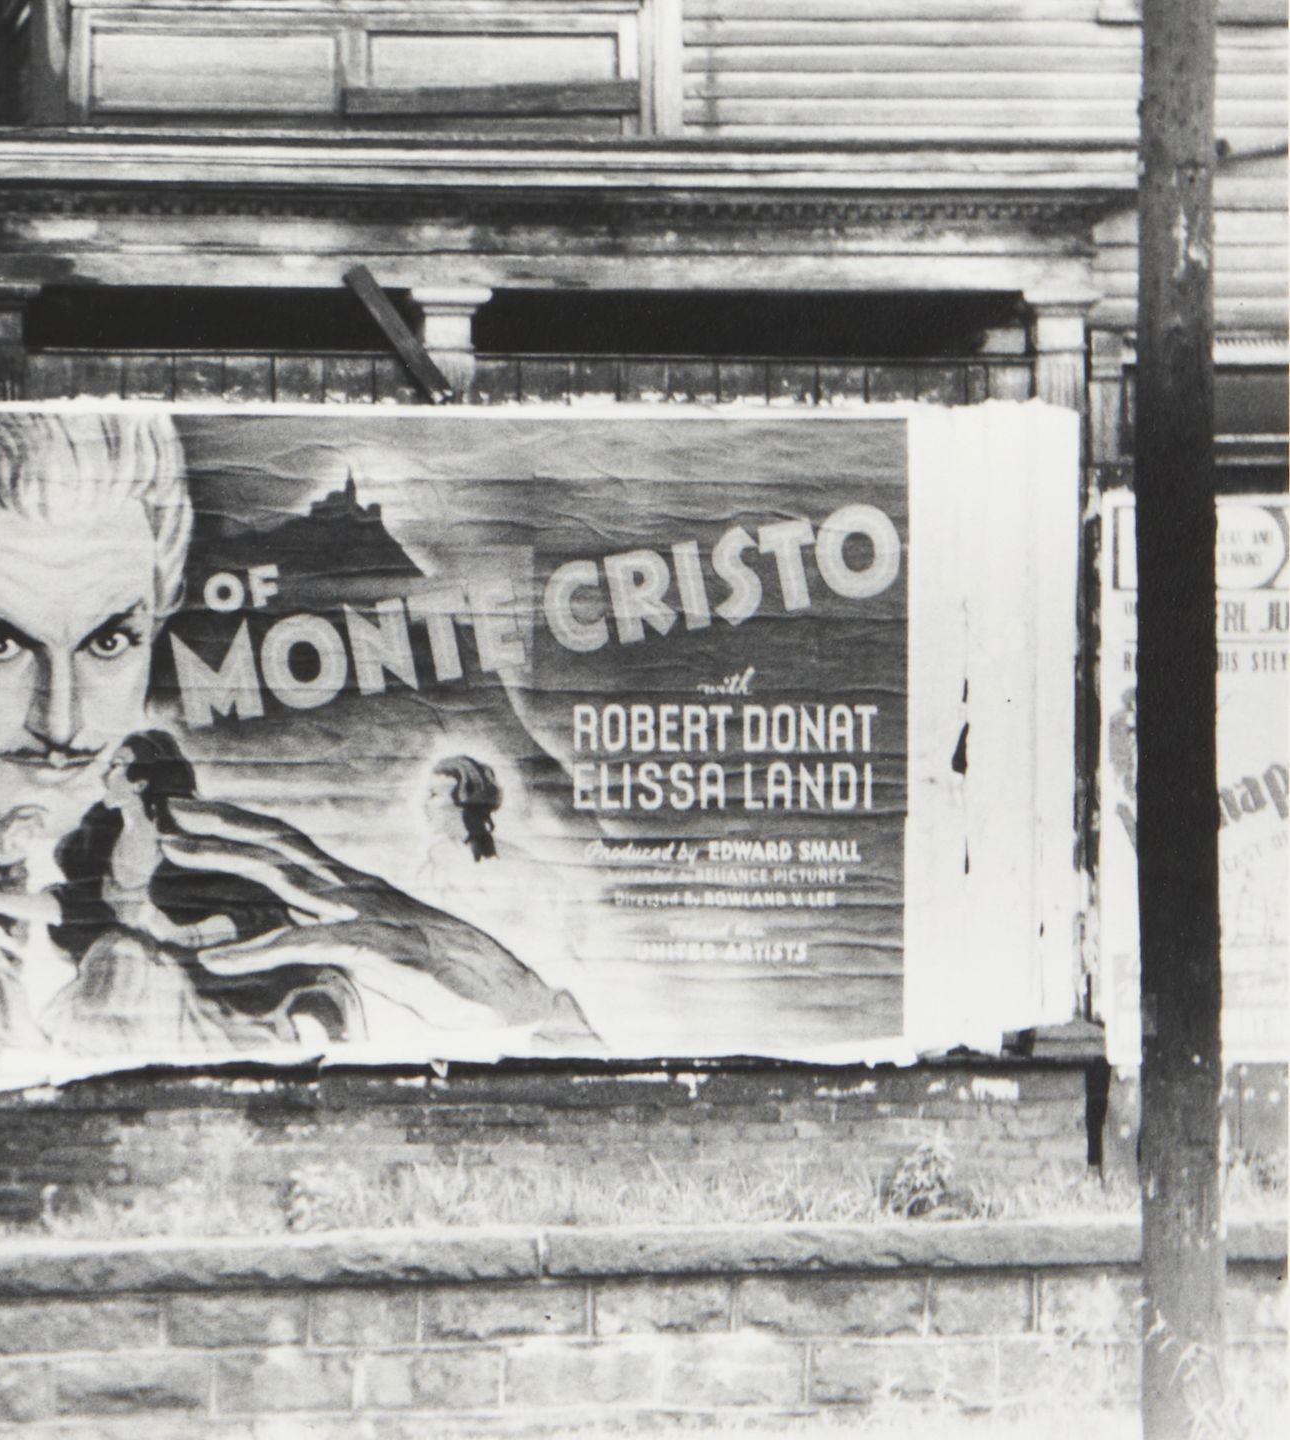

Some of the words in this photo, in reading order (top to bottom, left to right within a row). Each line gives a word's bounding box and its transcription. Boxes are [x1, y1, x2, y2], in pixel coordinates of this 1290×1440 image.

[204, 564, 282, 613] OF
[543, 503, 902, 653] CRISTO
[170, 576, 527, 731] MONTE
[696, 666, 756, 696] with
[573, 704, 733, 753] ROBERT
[742, 704, 878, 753] DONAT
[573, 762, 726, 811] ELISSA
[743, 762, 873, 811] LANDI
[584, 839, 675, 862] Produced
[677, 841, 699, 867] by
[708, 840, 793, 862] EDWARD
[798, 840, 862, 863] SMALL
[773, 866, 846, 885] PICTURES
[704, 891, 787, 907] ROWLAND
[808, 891, 837, 907] LEE
[723, 940, 808, 962] ARTISTS
